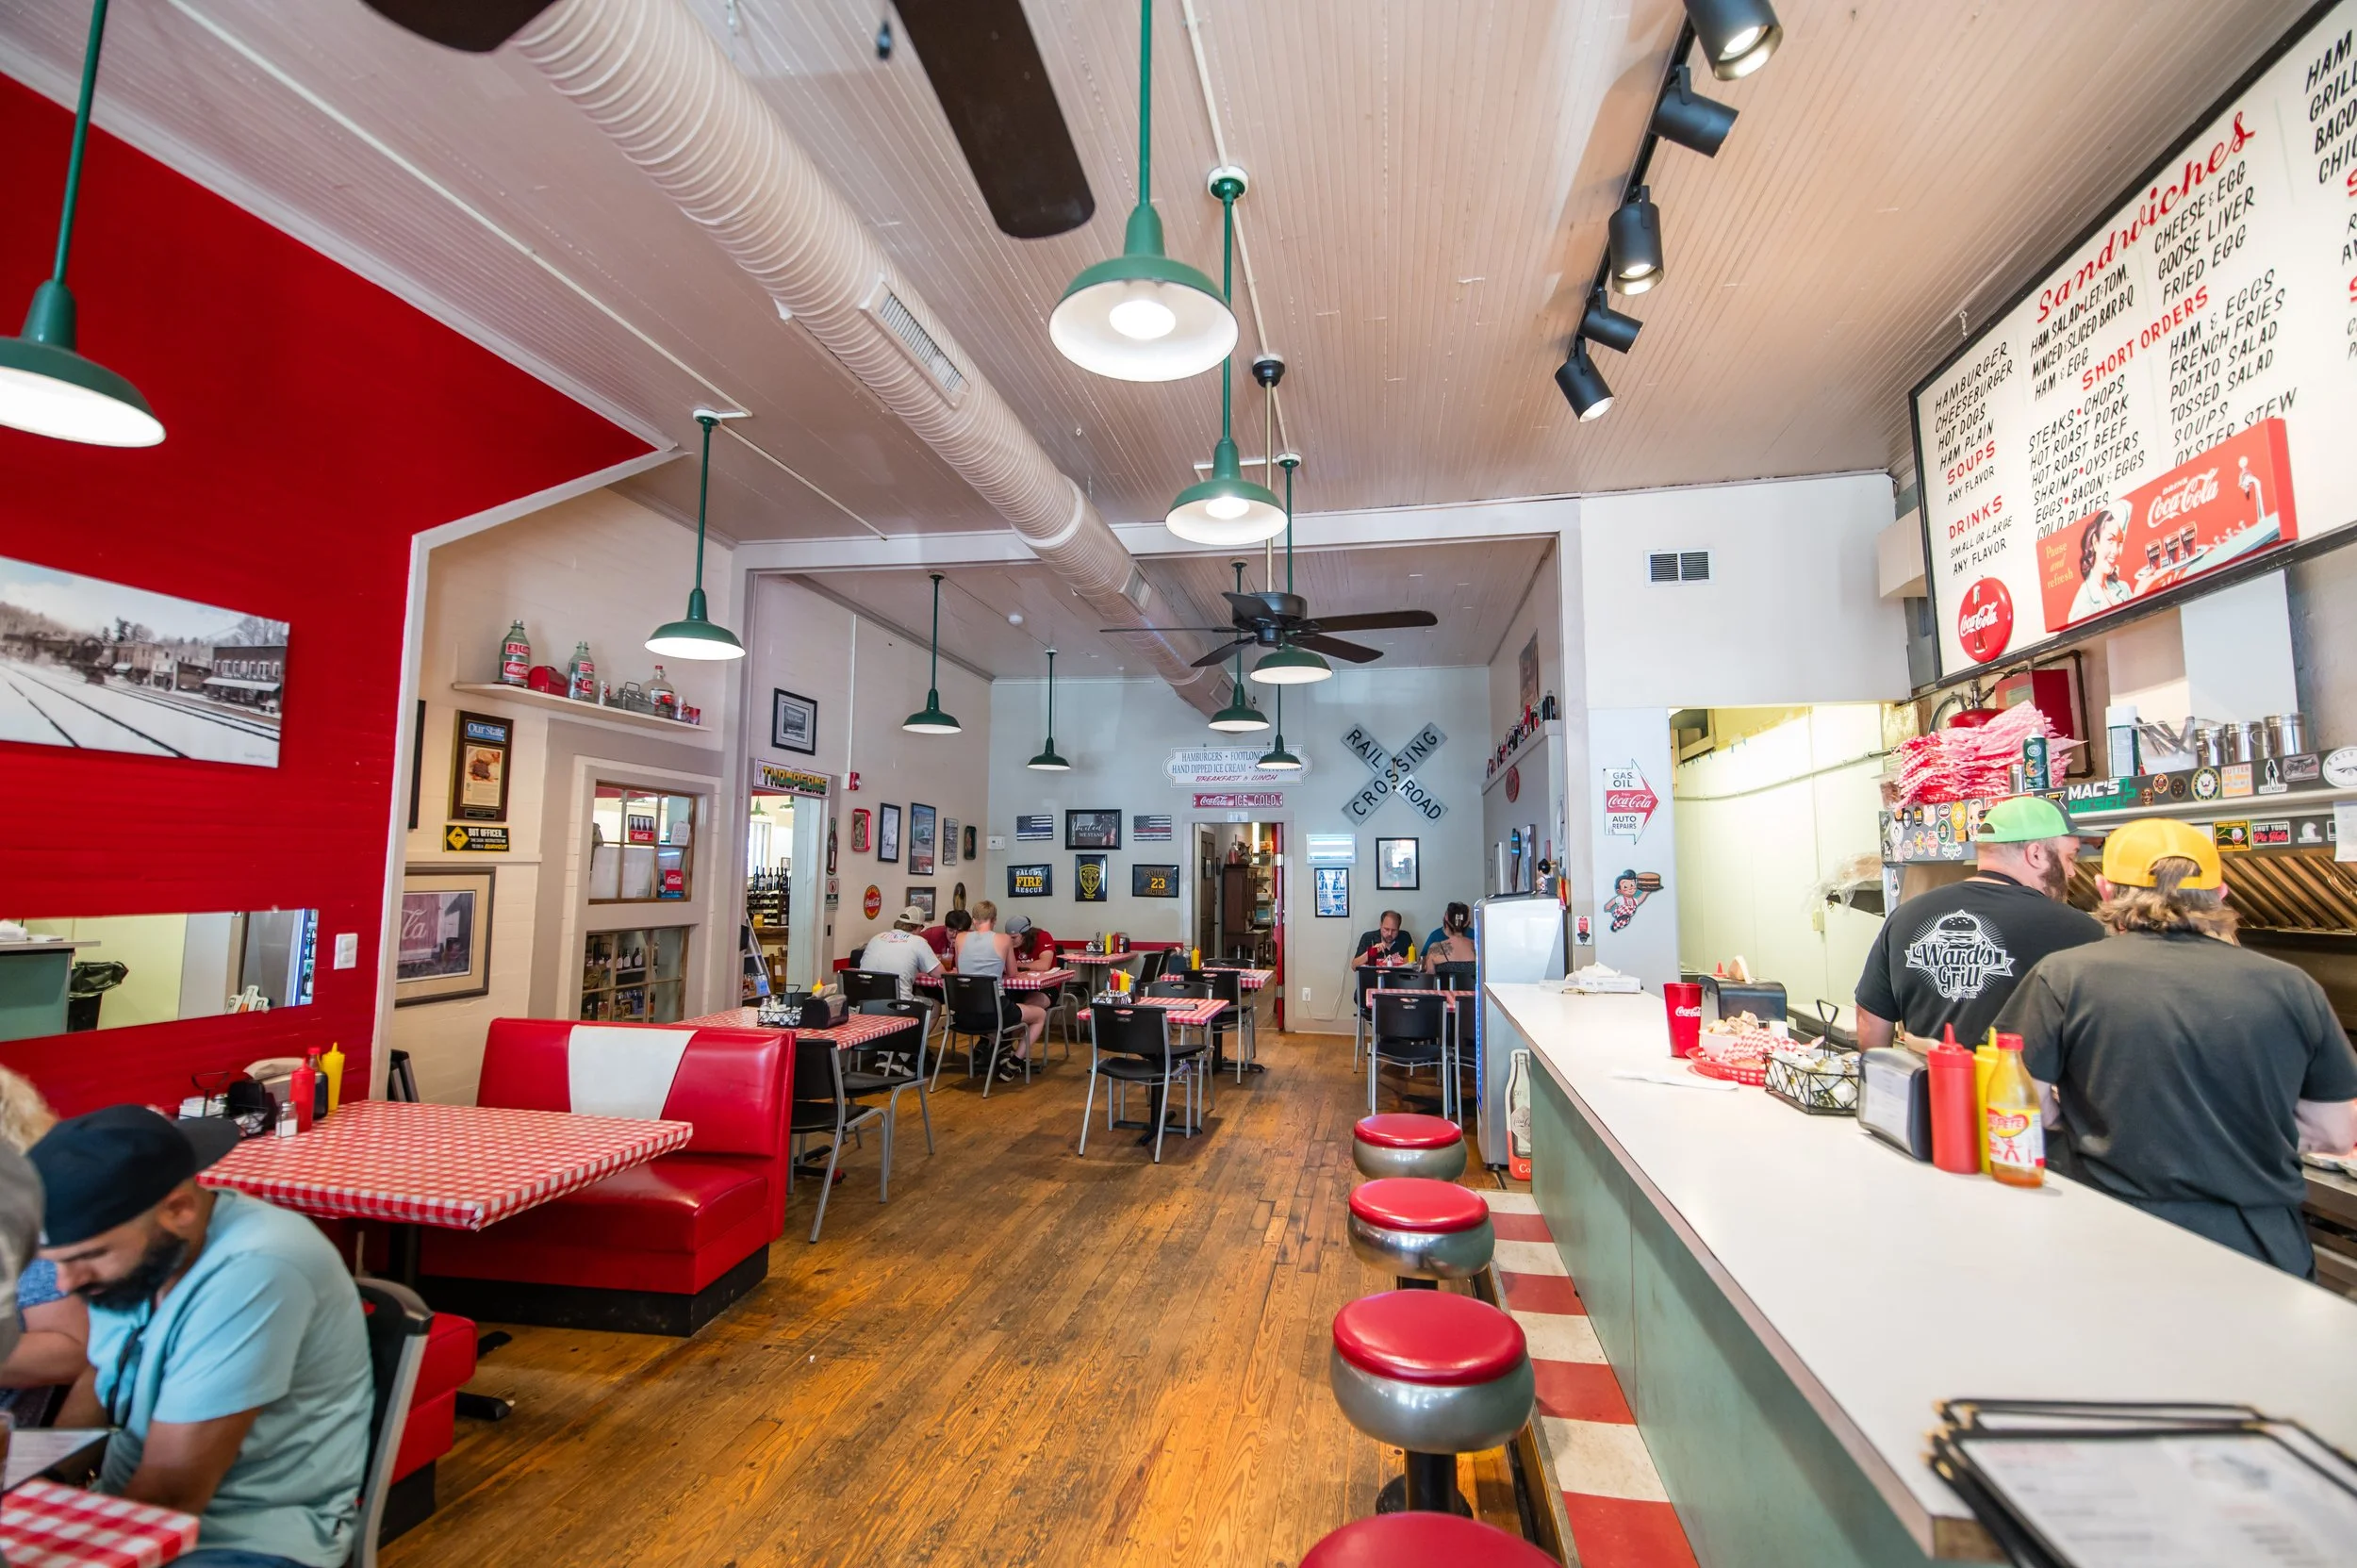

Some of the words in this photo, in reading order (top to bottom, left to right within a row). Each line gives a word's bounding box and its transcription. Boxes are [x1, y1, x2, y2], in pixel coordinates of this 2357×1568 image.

[2305, 29, 2353, 94] HAM
[2036, 110, 2256, 323] Sandwiches
[2154, 193, 2206, 254] CHEESE
[2217, 160, 2247, 203] EGG
[2158, 229, 2200, 281] GOOSE
[2208, 187, 2255, 242] LIVER
[2163, 258, 2205, 306] FRIED
[2212, 223, 2247, 268] EGG
[2031, 328, 2049, 357] HAM
[2052, 303, 2080, 340] SALAD
[2082, 338, 2134, 390] SHORT
[2140, 285, 2208, 349] ORDERS
[2169, 321, 2201, 359] HAM
[2225, 269, 2275, 321] EGGS
[2169, 326, 2230, 382] FRENCH
[2234, 288, 2285, 338] FRIES
[2032, 342, 2063, 381] MINCED
[2068, 315, 2098, 354] SLICED
[2100, 299, 2117, 328] BAR
[2170, 357, 2220, 404] POTATO
[2227, 321, 2278, 367] SALAD
[1935, 341, 2007, 415] HAMBURGER
[1935, 359, 2013, 434] CHEESEBURGER
[2035, 371, 2056, 402] HAM
[2067, 347, 2089, 378] EGG
[2170, 382, 2219, 426] TOSSED
[2227, 349, 2273, 391] SALAD
[1937, 425, 1957, 454] HOT
[1959, 402, 1986, 436] DOGS
[2028, 408, 2075, 454] STEAKS
[2084, 373, 2125, 416] CHOPS
[2173, 401, 2228, 448] SOUPS
[2244, 387, 2298, 427] STEW
[1939, 443, 1961, 471] HAM
[1964, 419, 1994, 454] PLAIN
[2030, 445, 2051, 471] HOT
[2052, 420, 2090, 457] ROAST
[2094, 393, 2130, 430] PORK
[2032, 464, 2052, 488] HOT
[2053, 441, 2088, 475] ROAST
[2094, 416, 2128, 451] BEEF
[1947, 440, 1996, 486] SOUPS
[1947, 487, 1963, 505] ANY
[1965, 465, 1995, 494] FLAVOR
[2034, 467, 2079, 506] SHRIMP
[2085, 430, 2139, 476] OYSTERS
[2036, 496, 2063, 525] EGGS
[2071, 473, 2104, 506] BACON
[2114, 449, 2145, 481] EGGS
[2147, 467, 2219, 529] Coca-Cola
[1949, 495, 2003, 539] DRINKS
[1950, 540, 1974, 558] SMALL
[1976, 531, 1985, 544] OR
[1986, 515, 2013, 539] LARGE
[1953, 558, 1968, 576] ANY
[1971, 537, 2007, 566] FLAVOR
[2045, 543, 2068, 560] Pause
[2049, 553, 2066, 572] and
[2047, 570, 2074, 589] refresh
[1960, 601, 1999, 637] Coca-Cola
[468, 722, 484, 734] Our
[1172, 764, 1189, 774] HAND
[1191, 764, 1212, 773] DIPPED
[1213, 764, 1225, 773] ICE
[1226, 763, 1246, 773] CREAM
[1181, 751, 1223, 762] HAMBURGERS
[1346, 729, 1383, 768] RAIL
[1400, 780, 1442, 819] ROAD
[1352, 731, 1438, 816] CROSSING
[1612, 771, 1634, 780] GAS
[1234, 795, 1249, 806] ICE
[1253, 795, 1277, 806] COLD
[1607, 793, 1653, 809] Coca-Cola
[1613, 779, 1633, 788] OIL
[2068, 778, 2120, 801] MAC'S
[2069, 797, 2128, 815] DIESEL
[468, 827, 480, 837] BUT
[1015, 868, 1043, 877] SALUDA
[1016, 876, 1043, 887] FIRE
[1150, 877, 1166, 889] 23
[1913, 939, 1995, 967] Ward's
[1938, 966, 1981, 994] Grill
